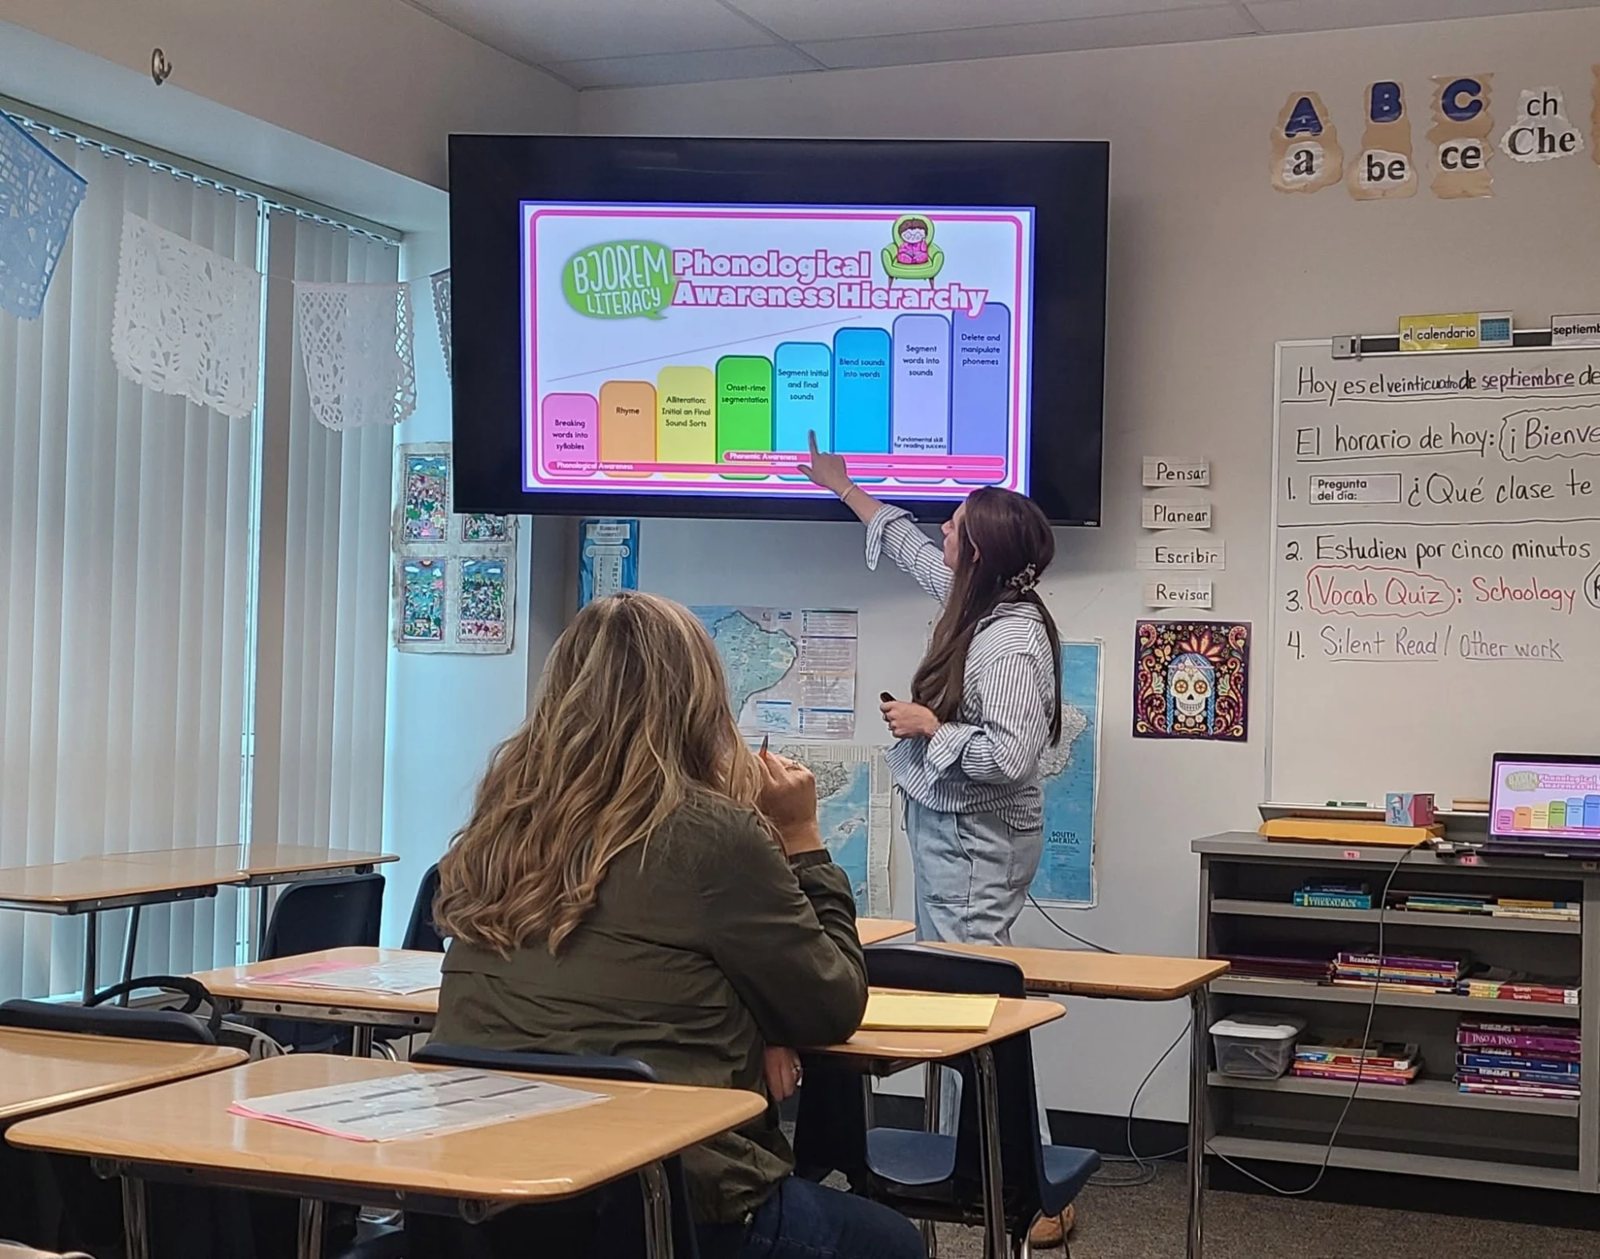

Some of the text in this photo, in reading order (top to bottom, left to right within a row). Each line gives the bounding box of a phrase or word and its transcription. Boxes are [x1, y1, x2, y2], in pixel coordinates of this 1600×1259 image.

[1370, 81, 1402, 123] B
[1441, 78, 1483, 121] C
[1526, 92, 1558, 116] ch
[1284, 96, 1323, 138] A
[1507, 127, 1576, 157] Che
[1440, 144, 1481, 169] ce
[1292, 150, 1316, 176] a
[1366, 154, 1406, 181] be
[573, 245, 669, 294] BJOREM
[672, 249, 871, 285] Phonological
[586, 288, 661, 315] LITERACY
[671, 280, 989, 318] Awareness Hierarchy
[961, 333, 985, 341] Delete
[1403, 327, 1476, 340] el calendario
[906, 345, 937, 354] Segment
[961, 346, 1001, 355] manipulate
[839, 358, 885, 366] Blend sounds
[902, 357, 940, 365] words into
[962, 358, 999, 366] phonemes
[778, 369, 809, 378] Segment
[843, 370, 881, 378] into words
[726, 384, 766, 392] Onset-rime
[787, 380, 819, 389] and final
[1299, 366, 1337, 407] Hoy
[1343, 379, 1366, 395] es
[1369, 373, 1384, 394] el
[1458, 370, 1476, 390] de
[1481, 367, 1574, 393] septiembre
[666, 396, 707, 405] Alliteration:
[721, 395, 769, 405] segmentation
[790, 393, 814, 401] sounds
[616, 406, 640, 416] Rhyme
[662, 407, 682, 416] Initial
[694, 407, 711, 416] Final
[554, 419, 586, 429] Breaking
[666, 419, 707, 428] Sound Sorts
[552, 431, 588, 439] words into
[897, 435, 932, 443] Fundamental
[1296, 427, 1321, 455] El
[1335, 424, 1411, 451] horario
[1419, 426, 1443, 449] de
[1450, 422, 1495, 458] hoy:
[556, 443, 585, 452] syllables
[903, 442, 925, 450] reading
[762, 453, 798, 461] Awareness
[598, 462, 634, 471] Awareness
[1156, 462, 1206, 480] Pensar
[1317, 479, 1367, 491] Pregunta
[1408, 473, 1485, 507] ¿Qué
[1496, 475, 1555, 503] clase
[1566, 468, 1593, 496] te
[1317, 491, 1335, 501] del
[1153, 504, 1208, 522] Planear
[1155, 546, 1217, 563] Escribir
[1285, 542, 1303, 561] 2.
[1416, 542, 1445, 569] por
[1451, 540, 1503, 559] cinco
[1512, 536, 1591, 560] minutos
[1156, 583, 1209, 600] Revisar
[1285, 590, 1304, 612] 3.
[1315, 574, 1378, 606] Vocab
[1472, 576, 1576, 614] Schoology
[1287, 630, 1305, 660] 4.
[1320, 625, 1385, 655] Silent
[1395, 626, 1439, 654] Read
[1460, 630, 1508, 657] Other
[1514, 638, 1563, 659] work
[1047, 837, 1080, 845] AMERICA
[1471, 1033, 1490, 1043] PASO
[1499, 1035, 1517, 1045] PASO
